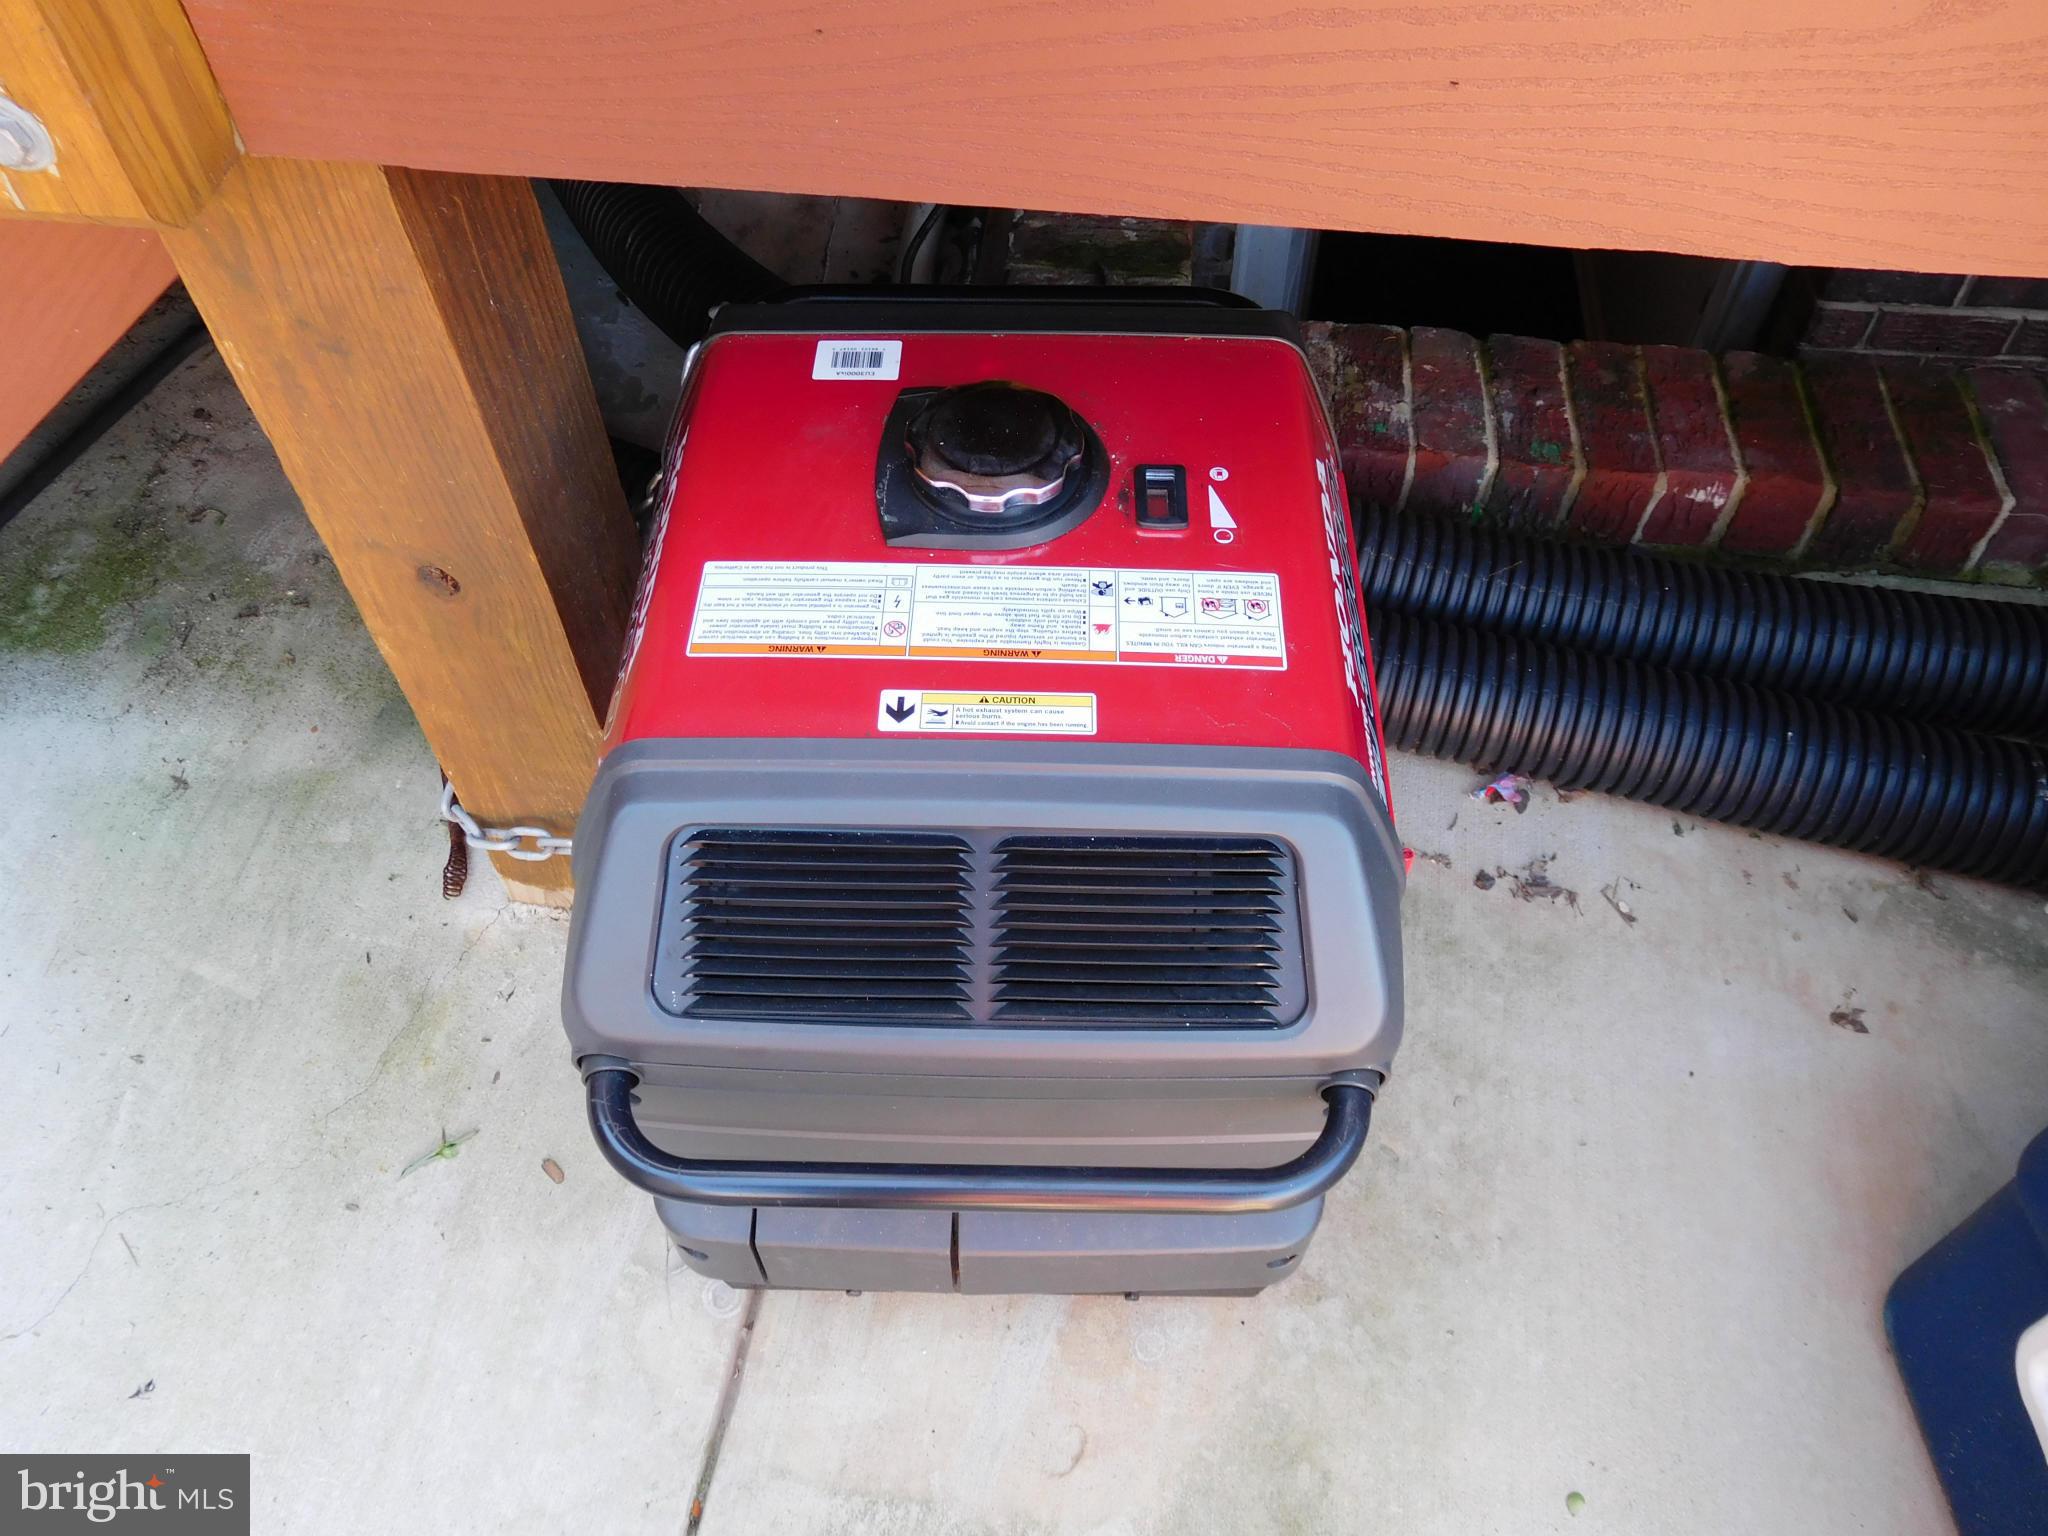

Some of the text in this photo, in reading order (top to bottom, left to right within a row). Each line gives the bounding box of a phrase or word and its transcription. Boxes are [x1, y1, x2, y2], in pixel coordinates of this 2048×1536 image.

[1315, 457, 1359, 708] HONDA
[768, 646, 814, 654] WARNING
[983, 649, 1029, 657] WARNING
[1174, 654, 1216, 663] DANGER
[992, 696, 1036, 704] CAUTION
